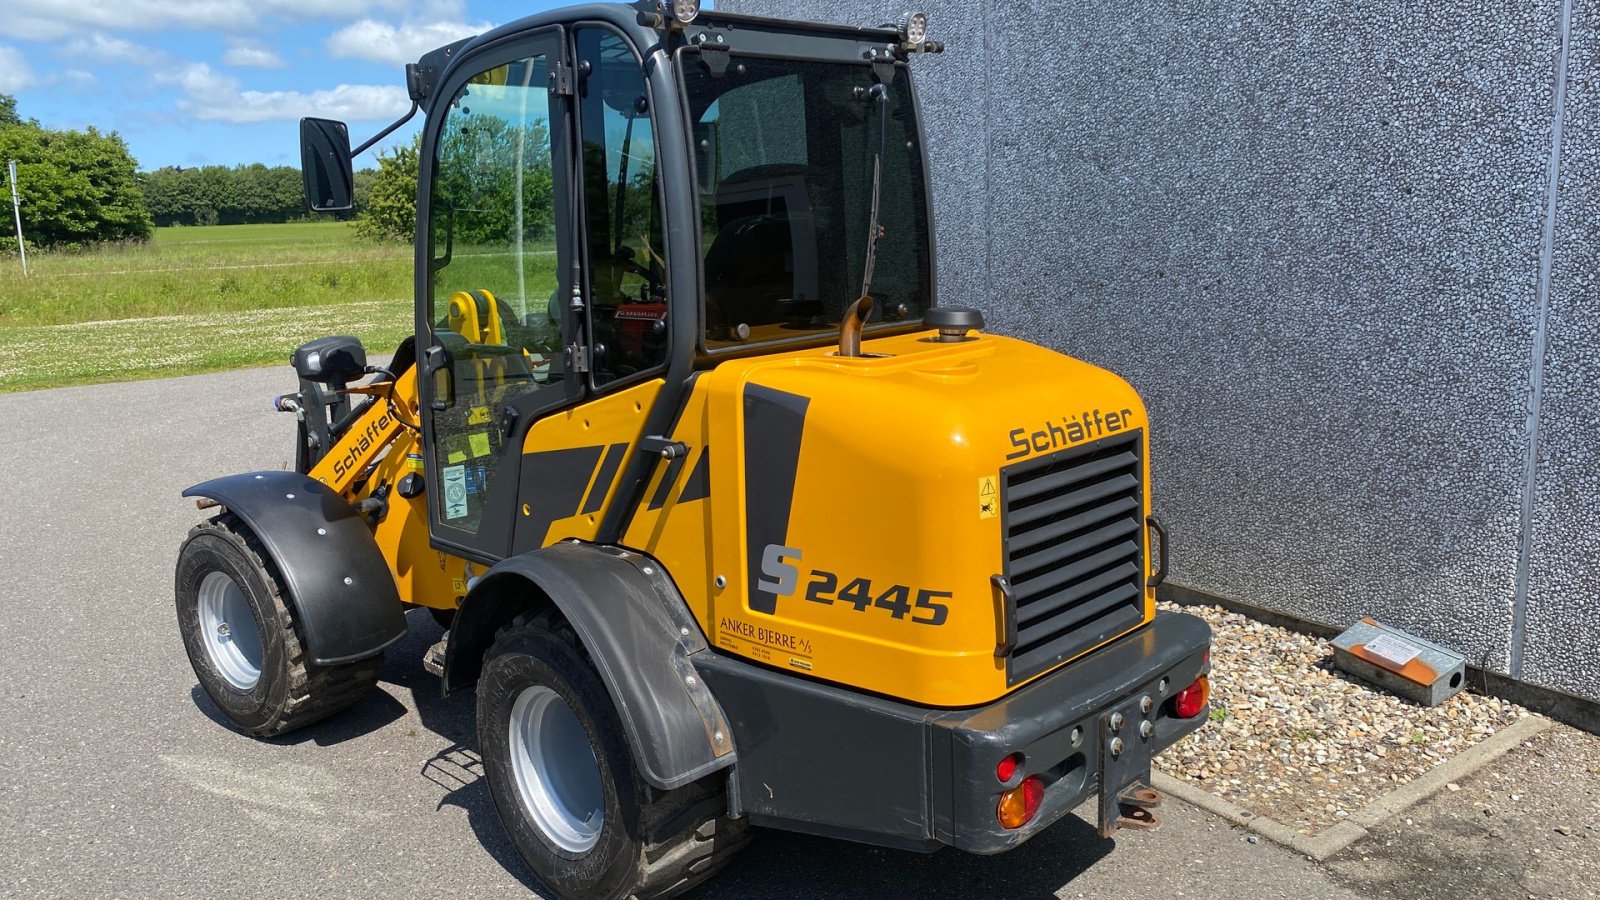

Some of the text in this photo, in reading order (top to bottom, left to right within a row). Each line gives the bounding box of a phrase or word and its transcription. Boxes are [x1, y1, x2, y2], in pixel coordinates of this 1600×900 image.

[334, 411, 394, 483] Schäffer
[1006, 408, 1132, 460] Schäffer
[758, 544, 953, 626] S 2445
[720, 617, 756, 638] ANKER
[758, 626, 796, 650] BJERRE
